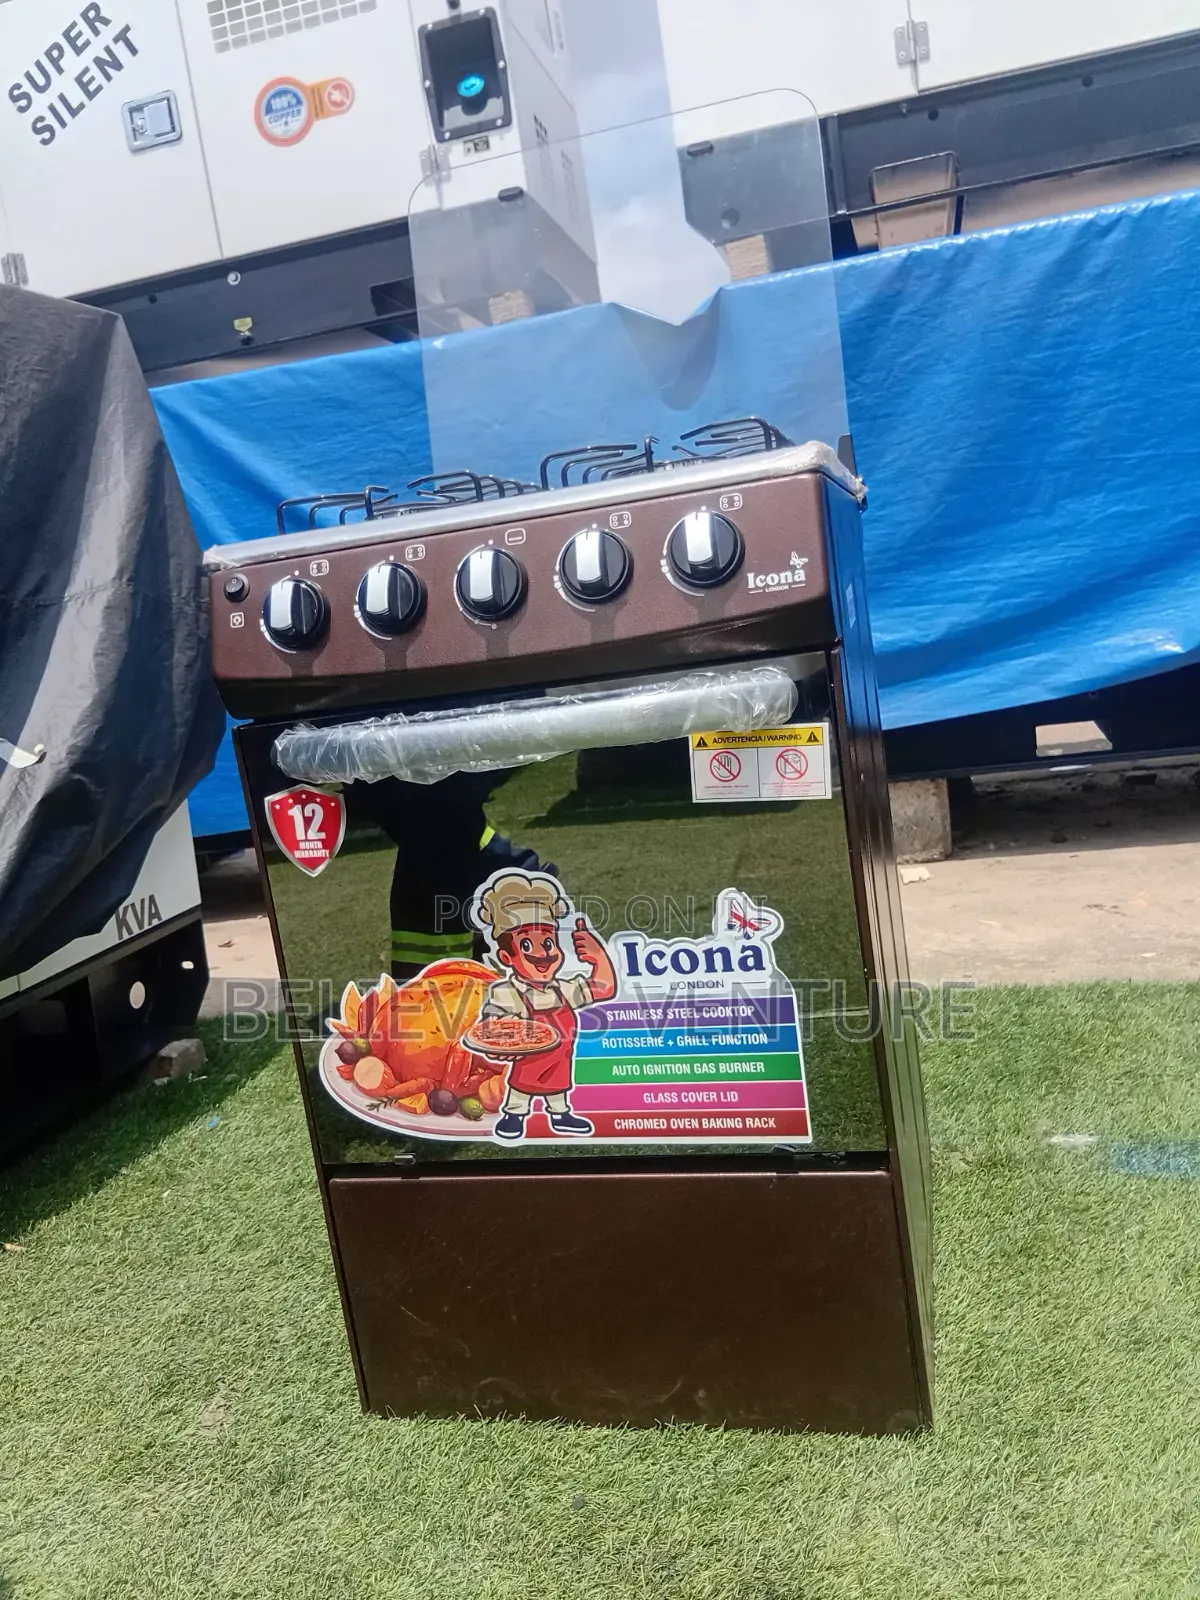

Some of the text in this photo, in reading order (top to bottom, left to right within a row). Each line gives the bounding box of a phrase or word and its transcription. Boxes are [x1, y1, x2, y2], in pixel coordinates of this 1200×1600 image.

[8, 1, 112, 114] SUPER
[31, 23, 139, 146] SILENT
[268, 108, 302, 124] COPPER
[747, 568, 806, 589] Icona
[765, 585, 789, 593] LONDON
[712, 735, 764, 744] ADVERTENCIA
[767, 733, 802, 742] WARNING
[287, 803, 327, 841] 12
[299, 840, 323, 850] MONTH
[293, 849, 330, 859] WARRANTY
[114, 894, 163, 941] KVA
[622, 942, 766, 977] Icona
[670, 979, 725, 990] LONDON
[606, 1005, 755, 1021] STAINLESS STEEL COOKTOP
[601, 1033, 769, 1049] ROTISSERIE + GRILL FUNCTION
[612, 1061, 765, 1076] AUTO IGNITION GAS BURNER
[643, 1090, 739, 1104] GLASS COVER LID
[614, 1117, 776, 1130] CHROMED OVEN BAKING RACK
